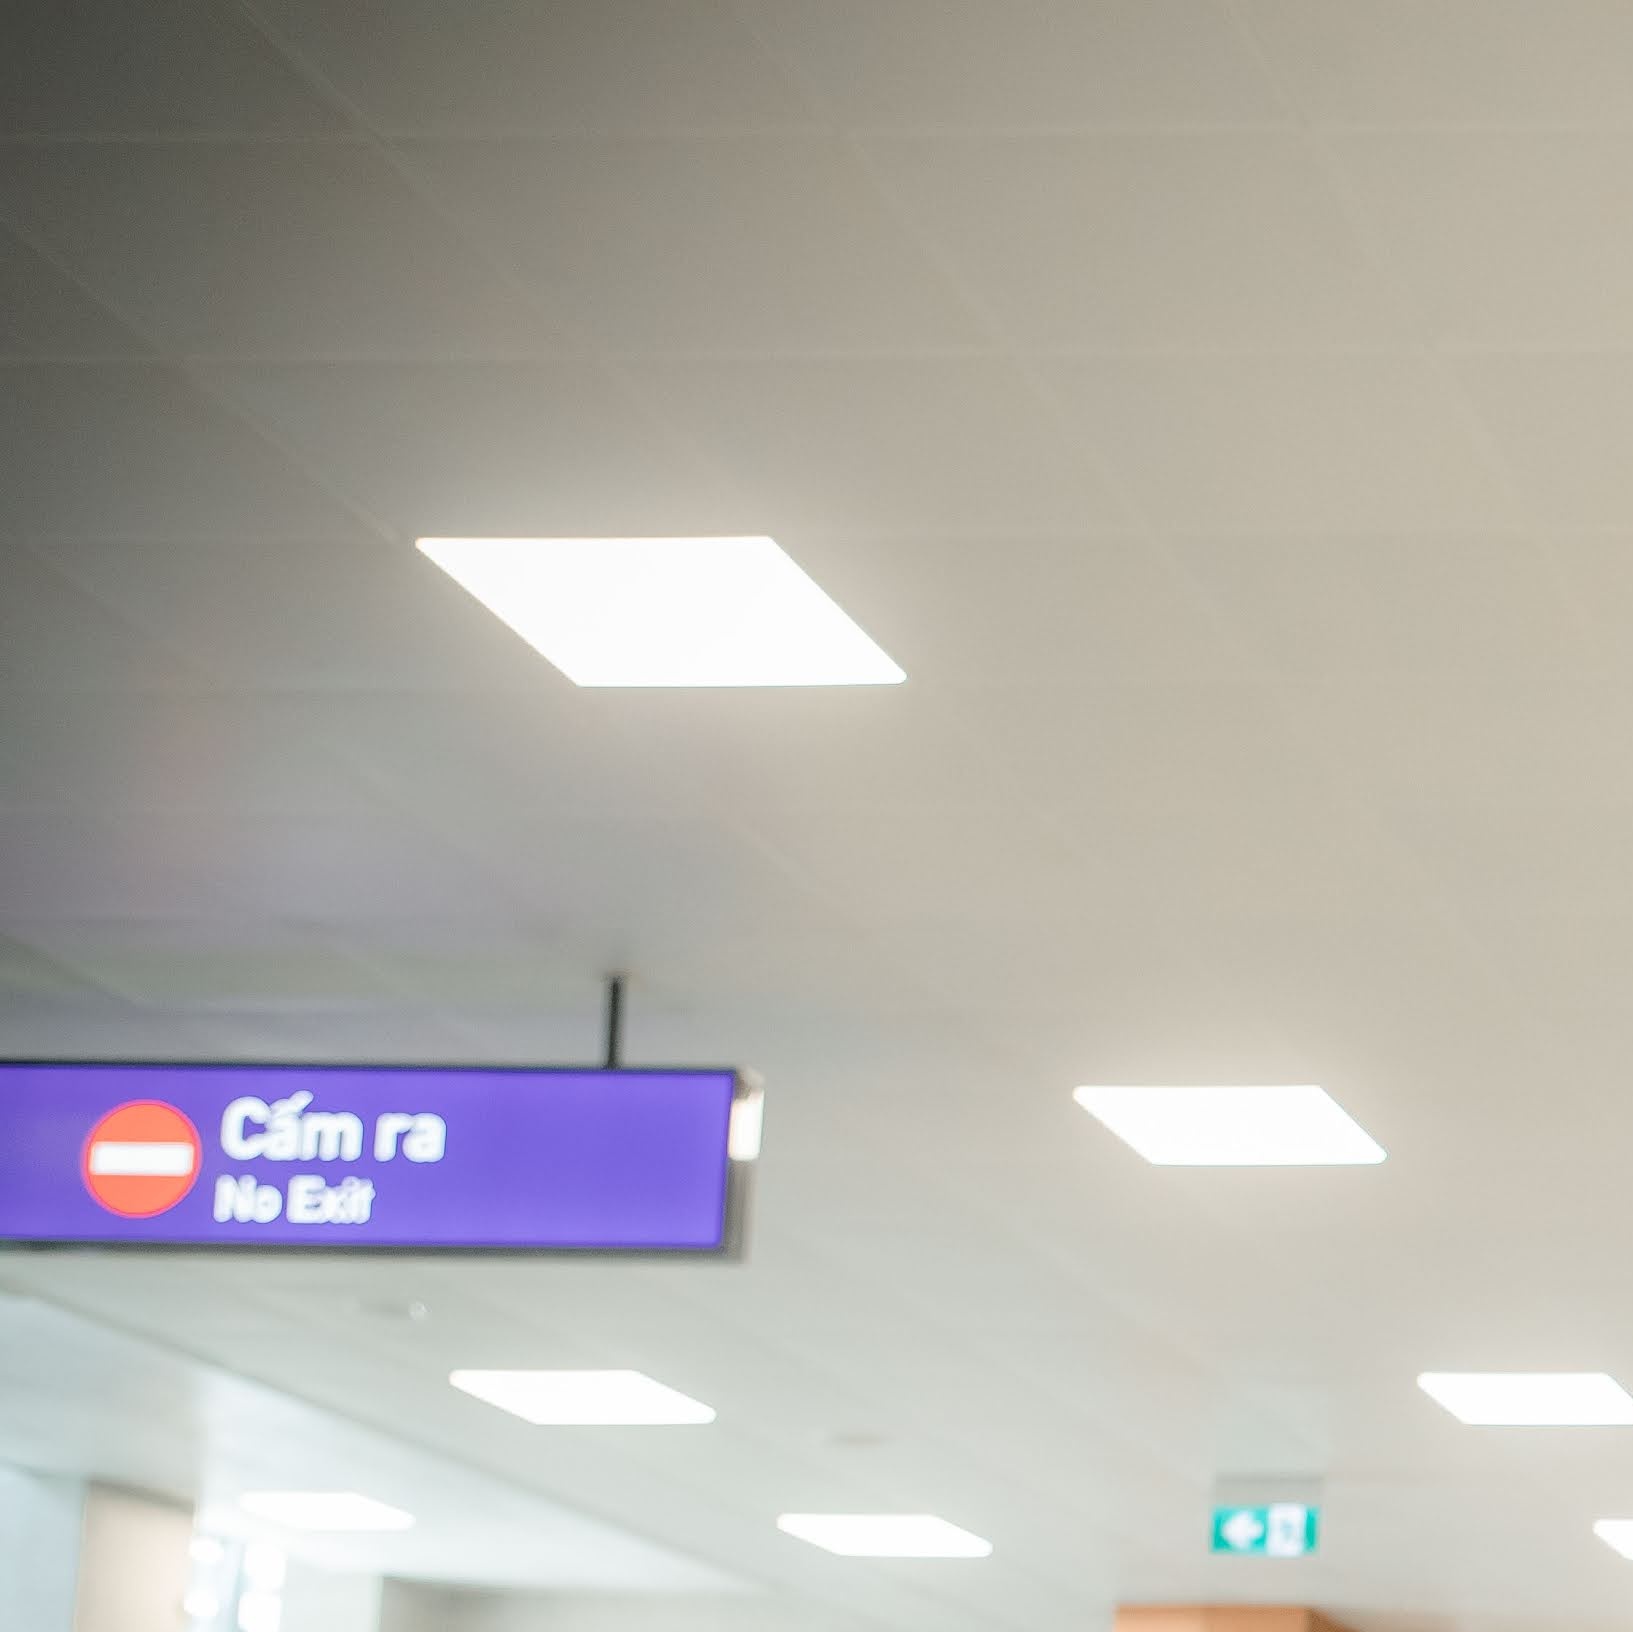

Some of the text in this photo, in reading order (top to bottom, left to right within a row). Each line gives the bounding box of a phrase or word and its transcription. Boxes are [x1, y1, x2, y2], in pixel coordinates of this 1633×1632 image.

[220, 1089, 447, 1163] Cấm ra
[213, 1173, 376, 1225] No Exit
